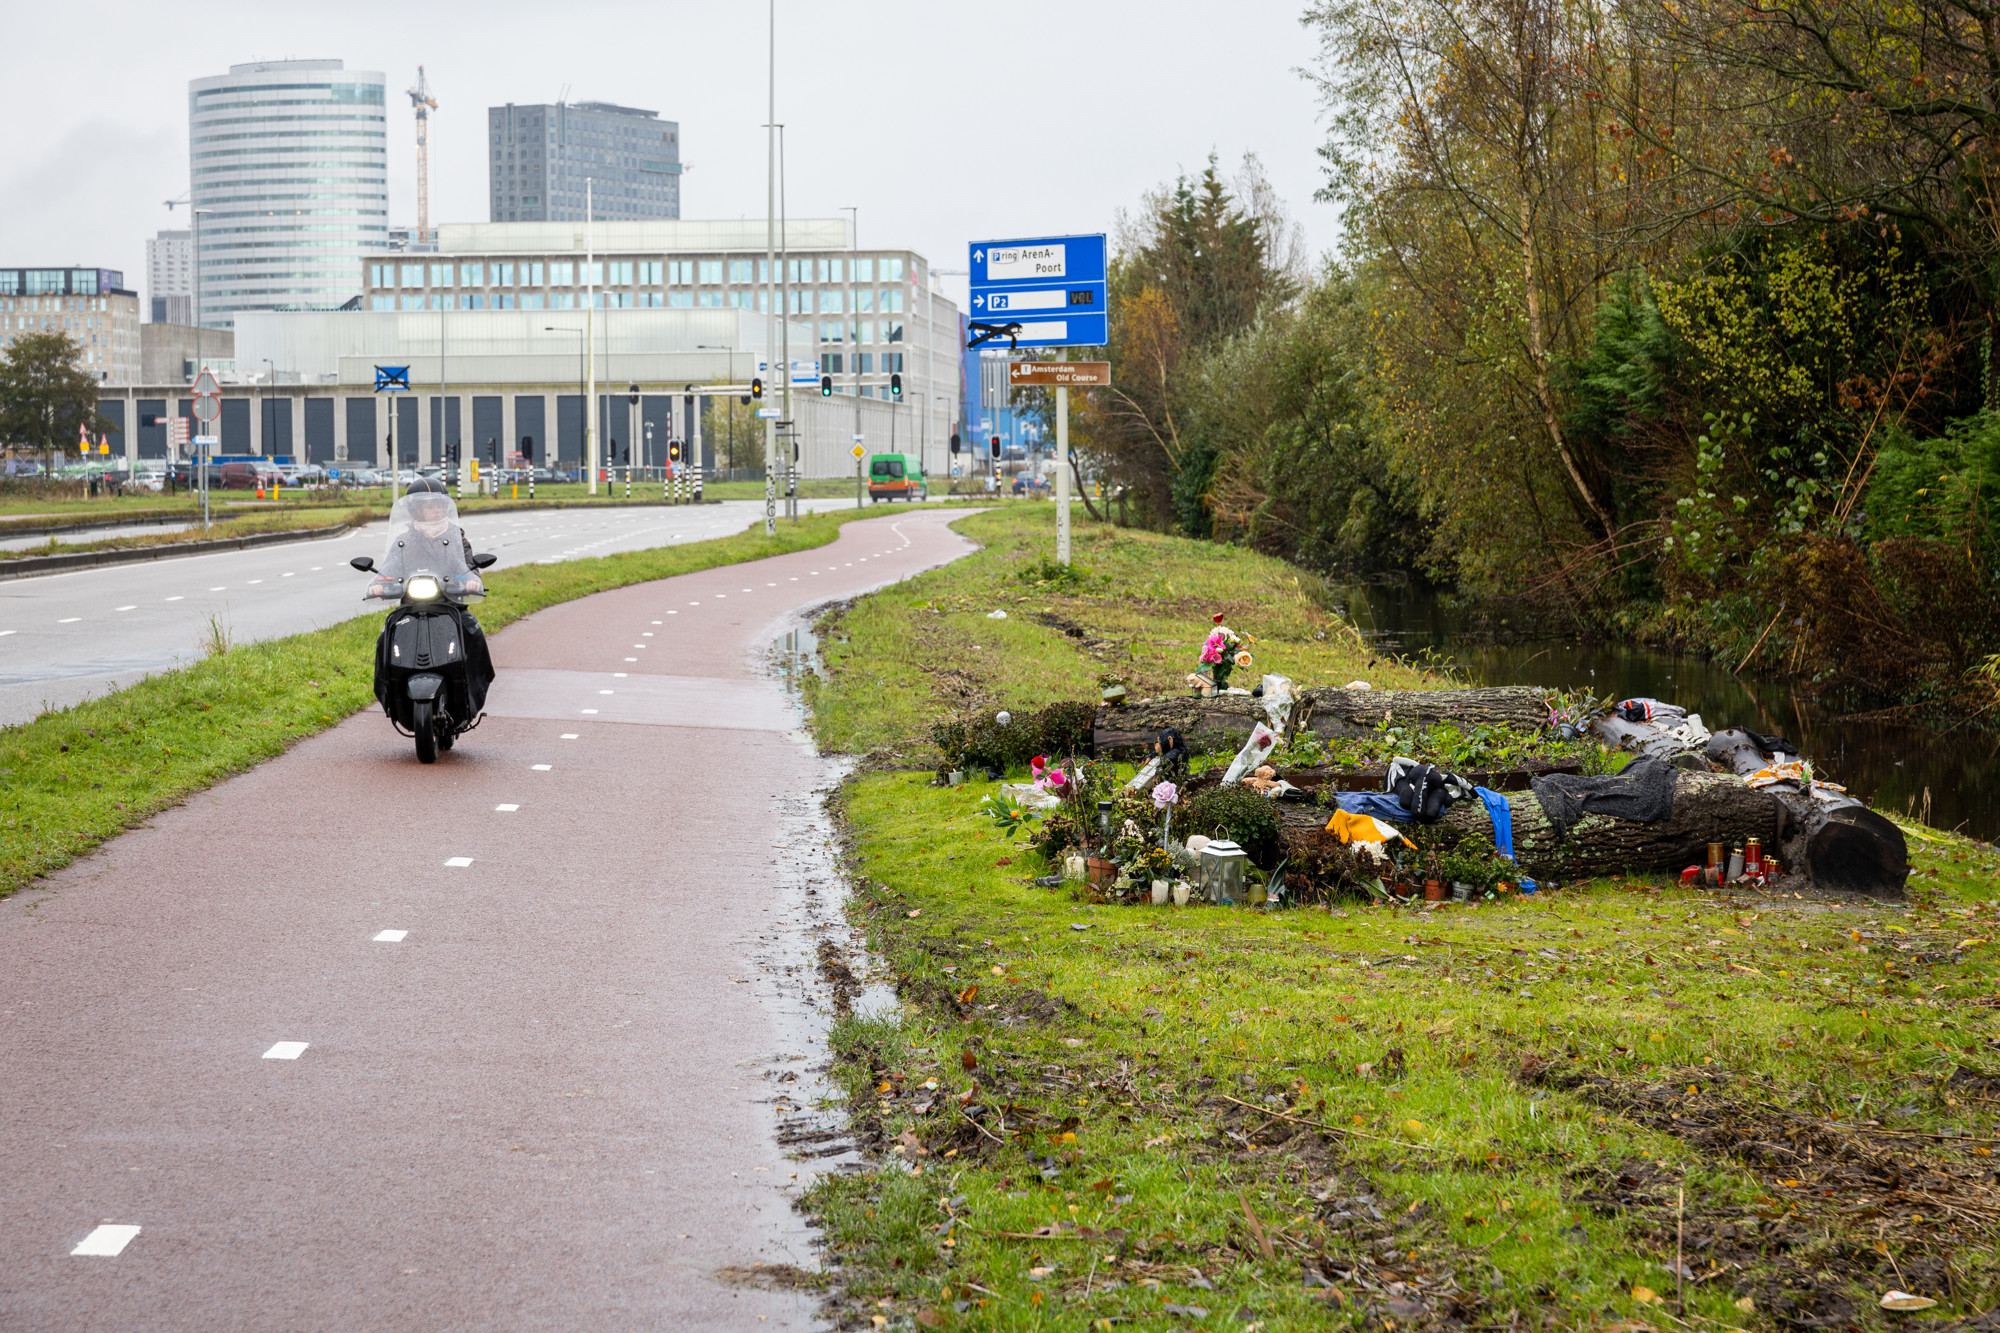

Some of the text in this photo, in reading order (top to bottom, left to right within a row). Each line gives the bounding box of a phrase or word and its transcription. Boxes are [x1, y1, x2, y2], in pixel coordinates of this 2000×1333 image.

[1001, 251, 1018, 262] ring
[1022, 249, 1054, 260] ArenA-
[1036, 263, 1061, 273] Poort
[993, 296, 1006, 308] P2
[1031, 365, 1075, 373] Amsterdam
[1056, 374, 1097, 382] Old Course
